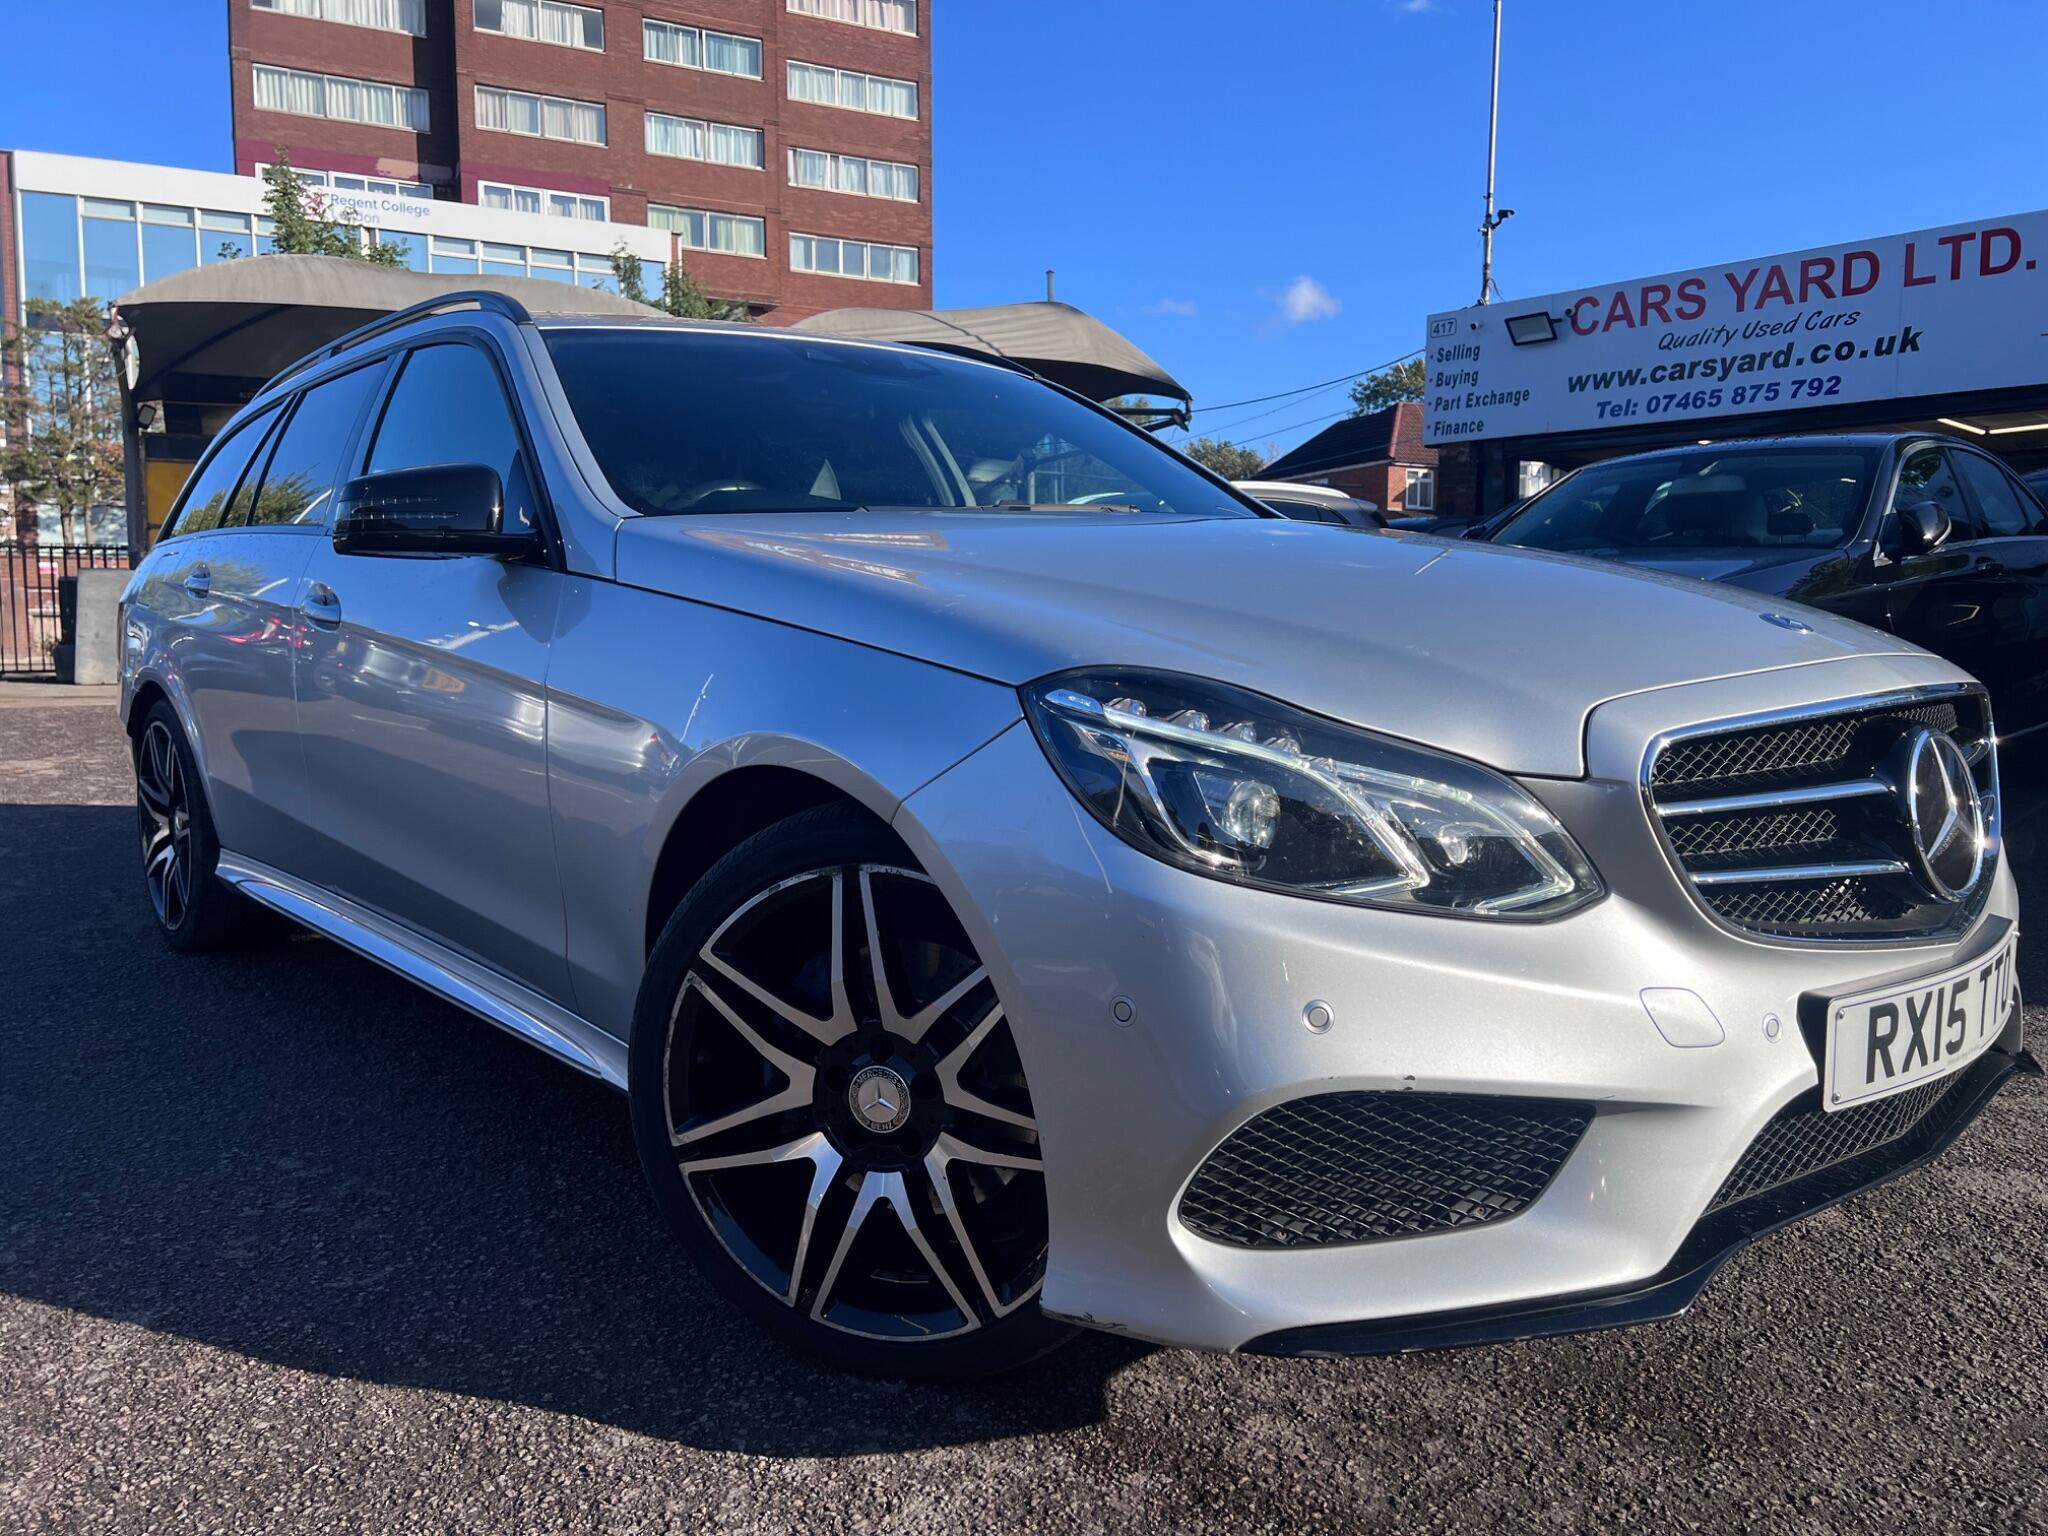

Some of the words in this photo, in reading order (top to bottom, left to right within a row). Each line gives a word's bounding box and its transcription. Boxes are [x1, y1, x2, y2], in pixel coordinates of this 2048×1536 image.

[330, 193, 378, 210] Regent
[381, 200, 431, 218] College
[1570, 278, 1706, 336] CARS
[1725, 250, 1880, 312] YARD
[1903, 227, 2037, 288] LTD.
[1433, 321, 1454, 335] 417
[1658, 324, 1738, 351] Quality
[1742, 312, 1802, 339] Used
[1805, 310, 1861, 331] Cars
[1436, 344, 1480, 363] Selling
[1568, 326, 1923, 393] www.carsyard.co.uk
[1435, 369, 1479, 389] Buying
[1434, 395, 1461, 412] Part
[1465, 388, 1530, 409] Exchange
[1596, 399, 1638, 419] Tel:
[1646, 389, 1723, 414] 07465
[1731, 382, 1781, 406] 875
[1790, 375, 1842, 399] 792
[1433, 419, 1485, 437] Finance
[1866, 977, 1970, 1085] RX15
[856, 1069, 898, 1084] MERCEDES
[870, 1121, 894, 1131] BENZ
